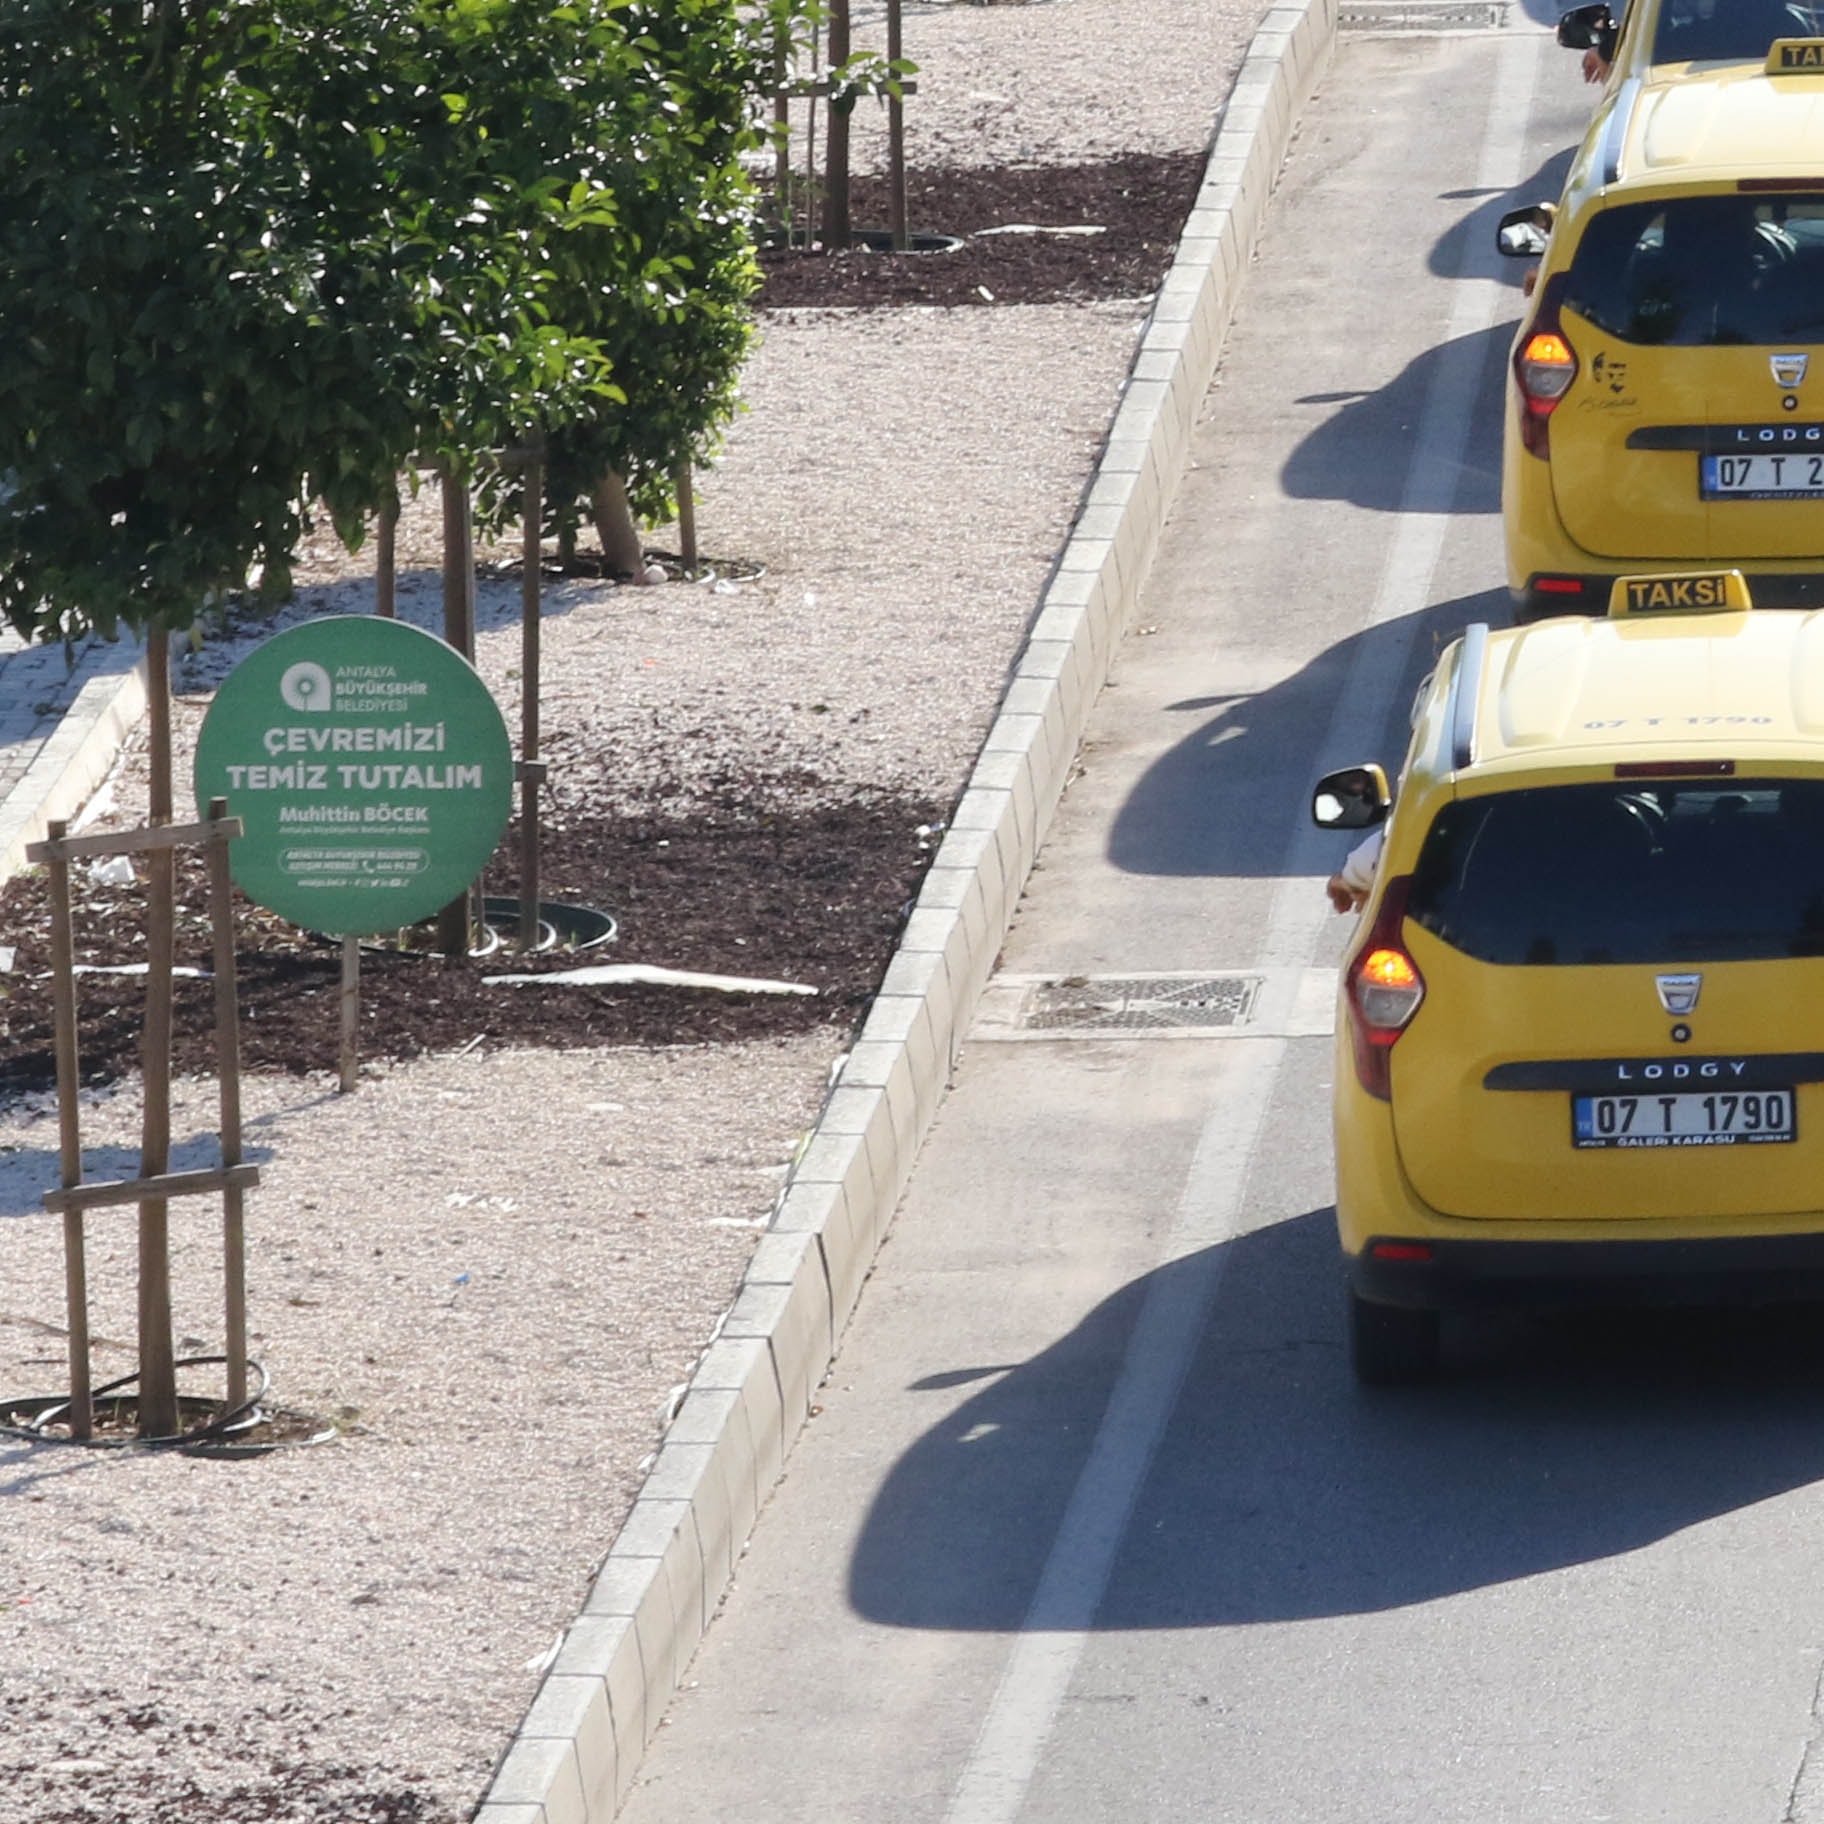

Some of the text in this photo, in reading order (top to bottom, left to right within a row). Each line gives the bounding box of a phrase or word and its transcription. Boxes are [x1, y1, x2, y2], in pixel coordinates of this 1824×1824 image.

[1720, 458, 1753, 487] 07
[1771, 458, 1787, 486] T
[336, 666, 397, 677] ANTALYA
[335, 681, 428, 697] BÜYÜKŞEHİR
[336, 697, 409, 712] BELEDİYESİ
[263, 721, 446, 756] ÇEVREMİZİ
[226, 759, 482, 789] TEMİZ TUTALIM
[280, 802, 429, 822] Muhittin BÖCEK
[1617, 1061, 1746, 1080] LODGY
[1597, 1095, 1785, 1133] 07 T 1790
[1672, 1134, 1736, 1147] KARASU
